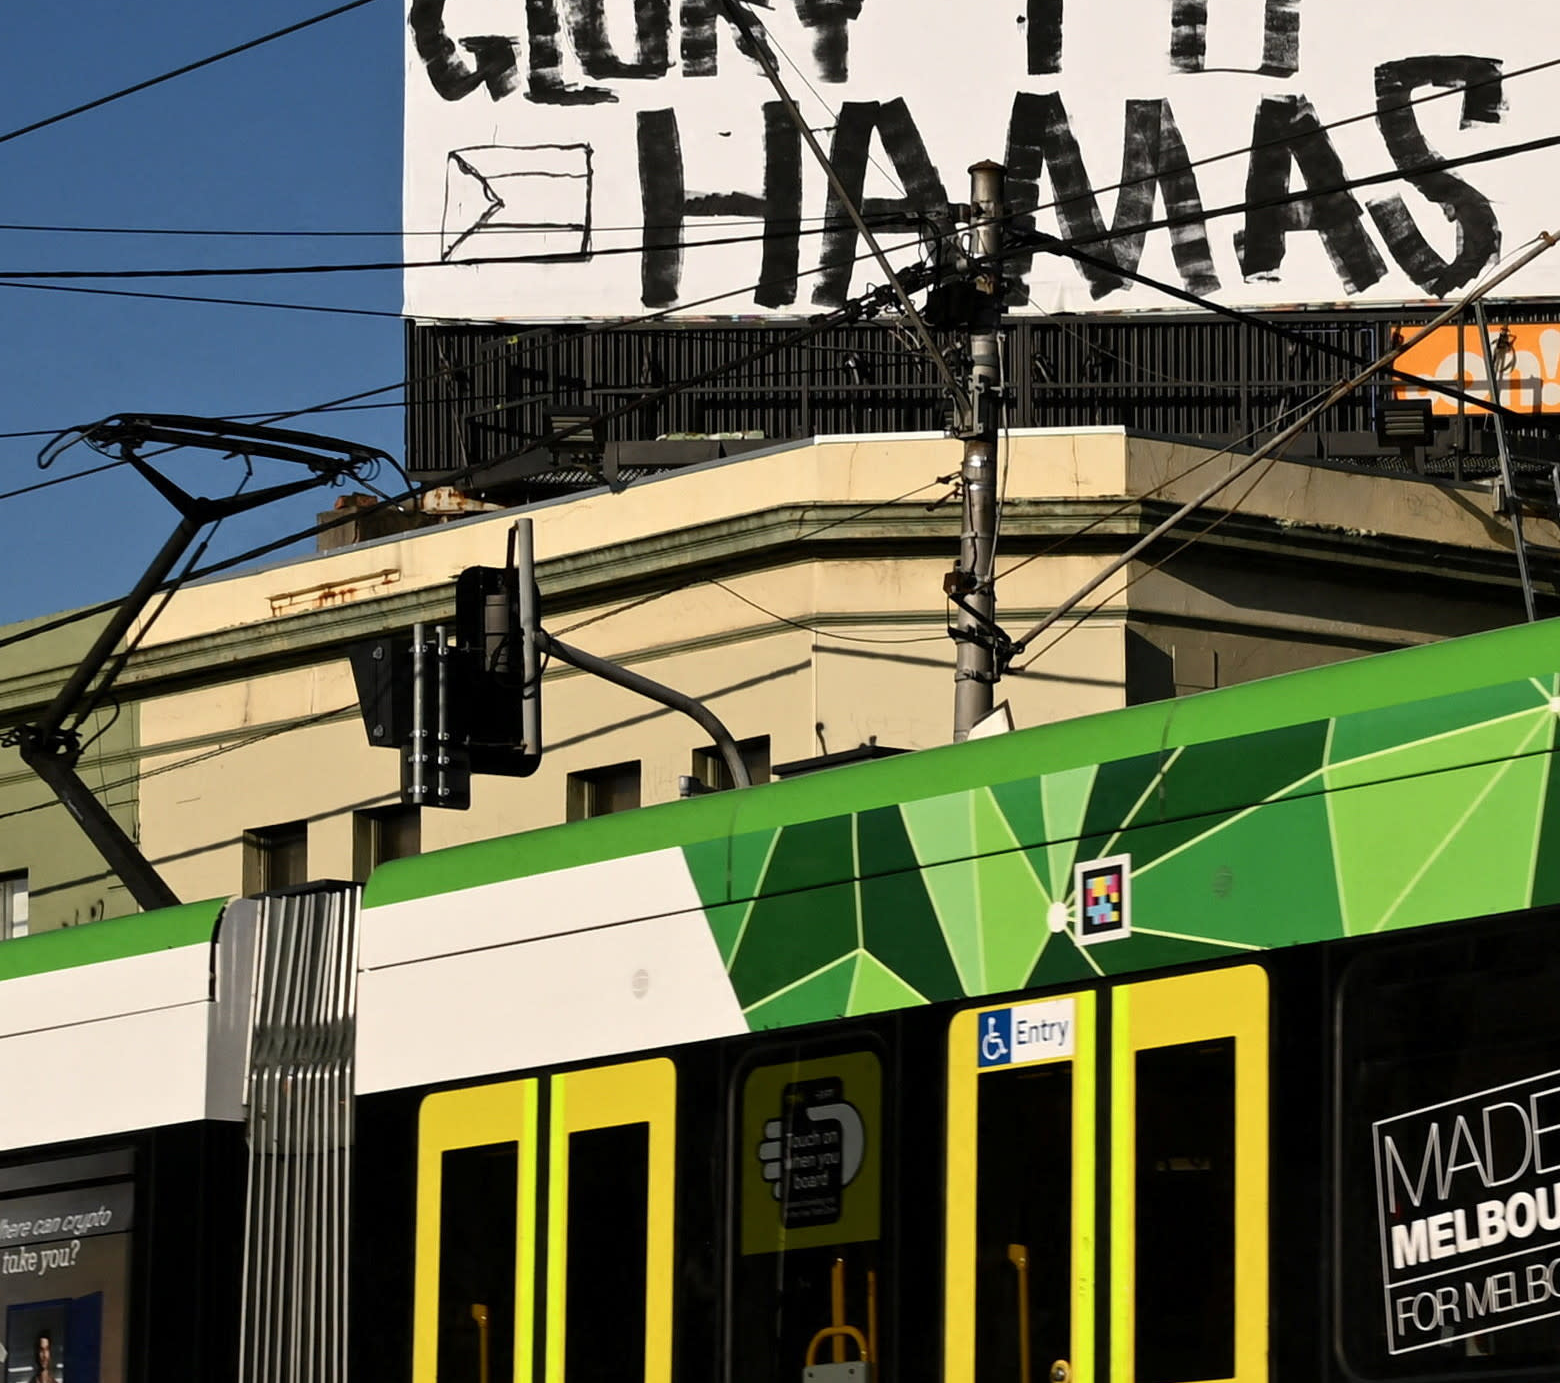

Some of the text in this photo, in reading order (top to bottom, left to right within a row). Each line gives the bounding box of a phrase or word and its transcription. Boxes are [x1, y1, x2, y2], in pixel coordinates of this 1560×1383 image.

[636, 54, 1511, 308] HAMAS
[1016, 1019, 1070, 1047] Entry
[33, 1215, 61, 1236] can
[62, 1205, 113, 1236] crypto
[1, 1239, 82, 1276] take you?
[1396, 1286, 1461, 1336] FOR
